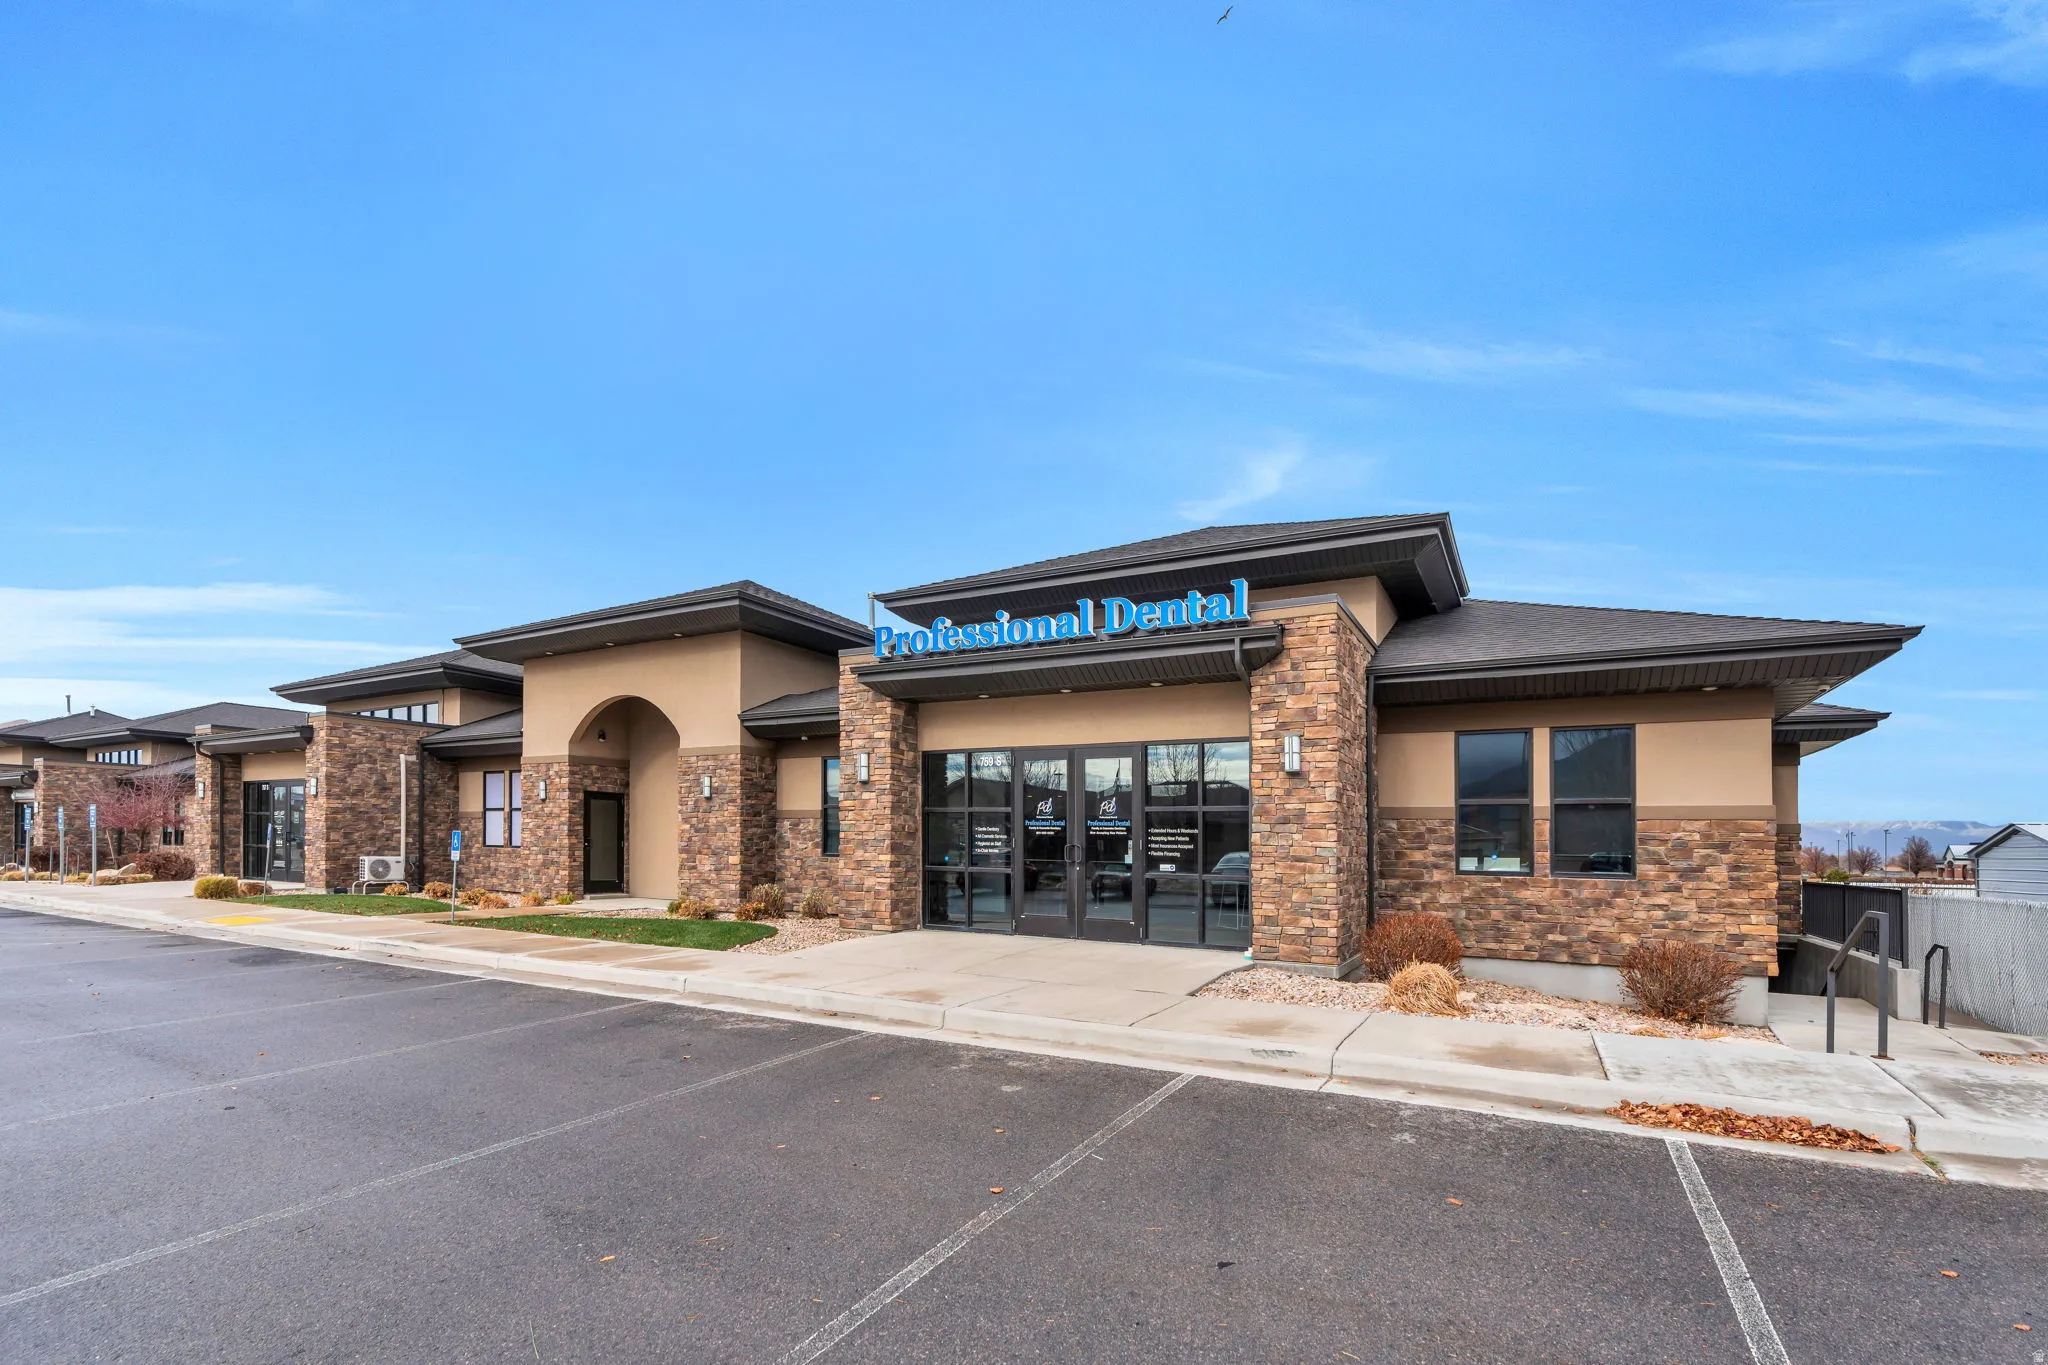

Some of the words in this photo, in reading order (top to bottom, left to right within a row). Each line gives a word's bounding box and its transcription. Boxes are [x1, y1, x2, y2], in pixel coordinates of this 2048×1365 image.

[873, 598, 1095, 658] Professional
[1102, 578, 1250, 635] Dental
[980, 756, 993, 767] 759
[996, 756, 1002, 766] S
